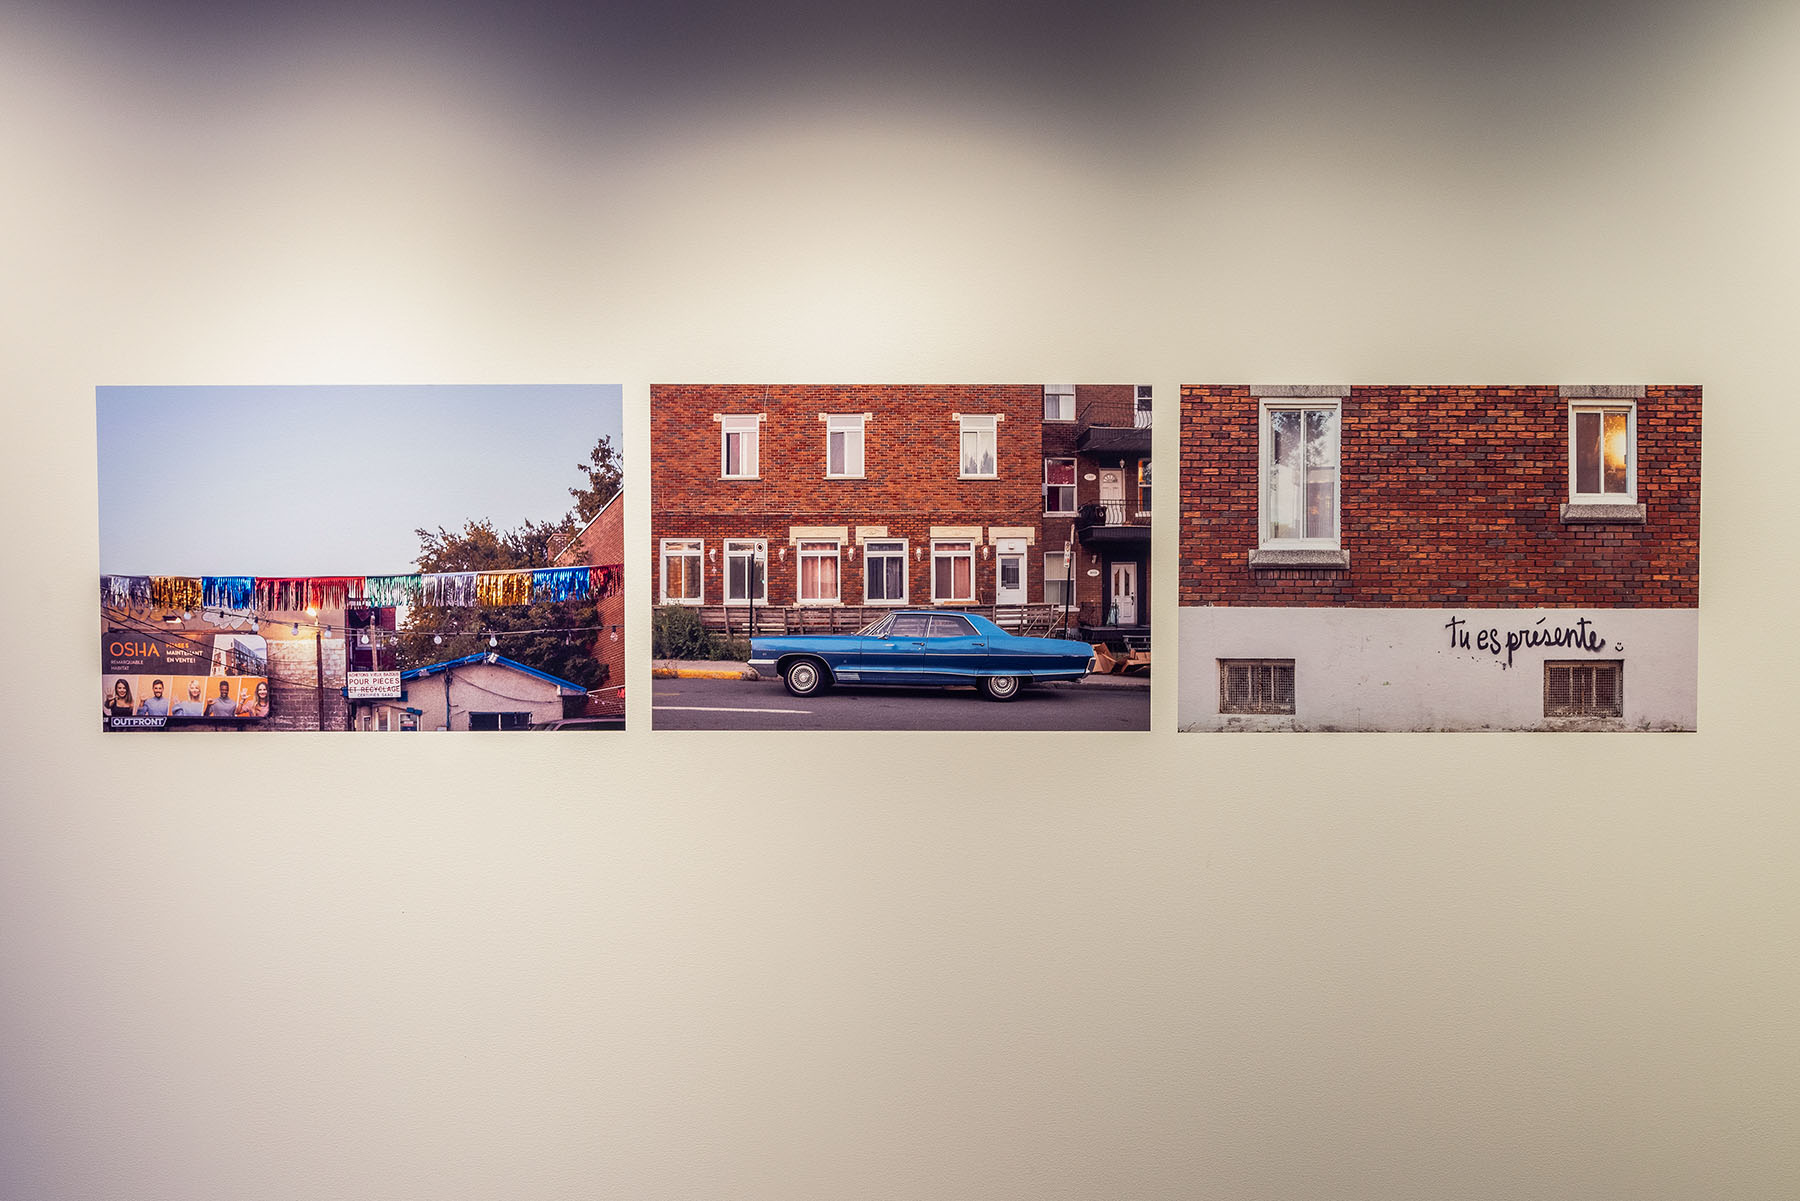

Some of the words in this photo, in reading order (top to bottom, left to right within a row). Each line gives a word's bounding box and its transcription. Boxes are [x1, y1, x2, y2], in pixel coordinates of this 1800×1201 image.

[1477, 628, 1501, 655] es
[110, 642, 160, 657] OSHA
[372, 677, 400, 685] PIECES
[360, 685, 400, 693] RECYCLAGE
[113, 717, 164, 726] OUTFRONT
